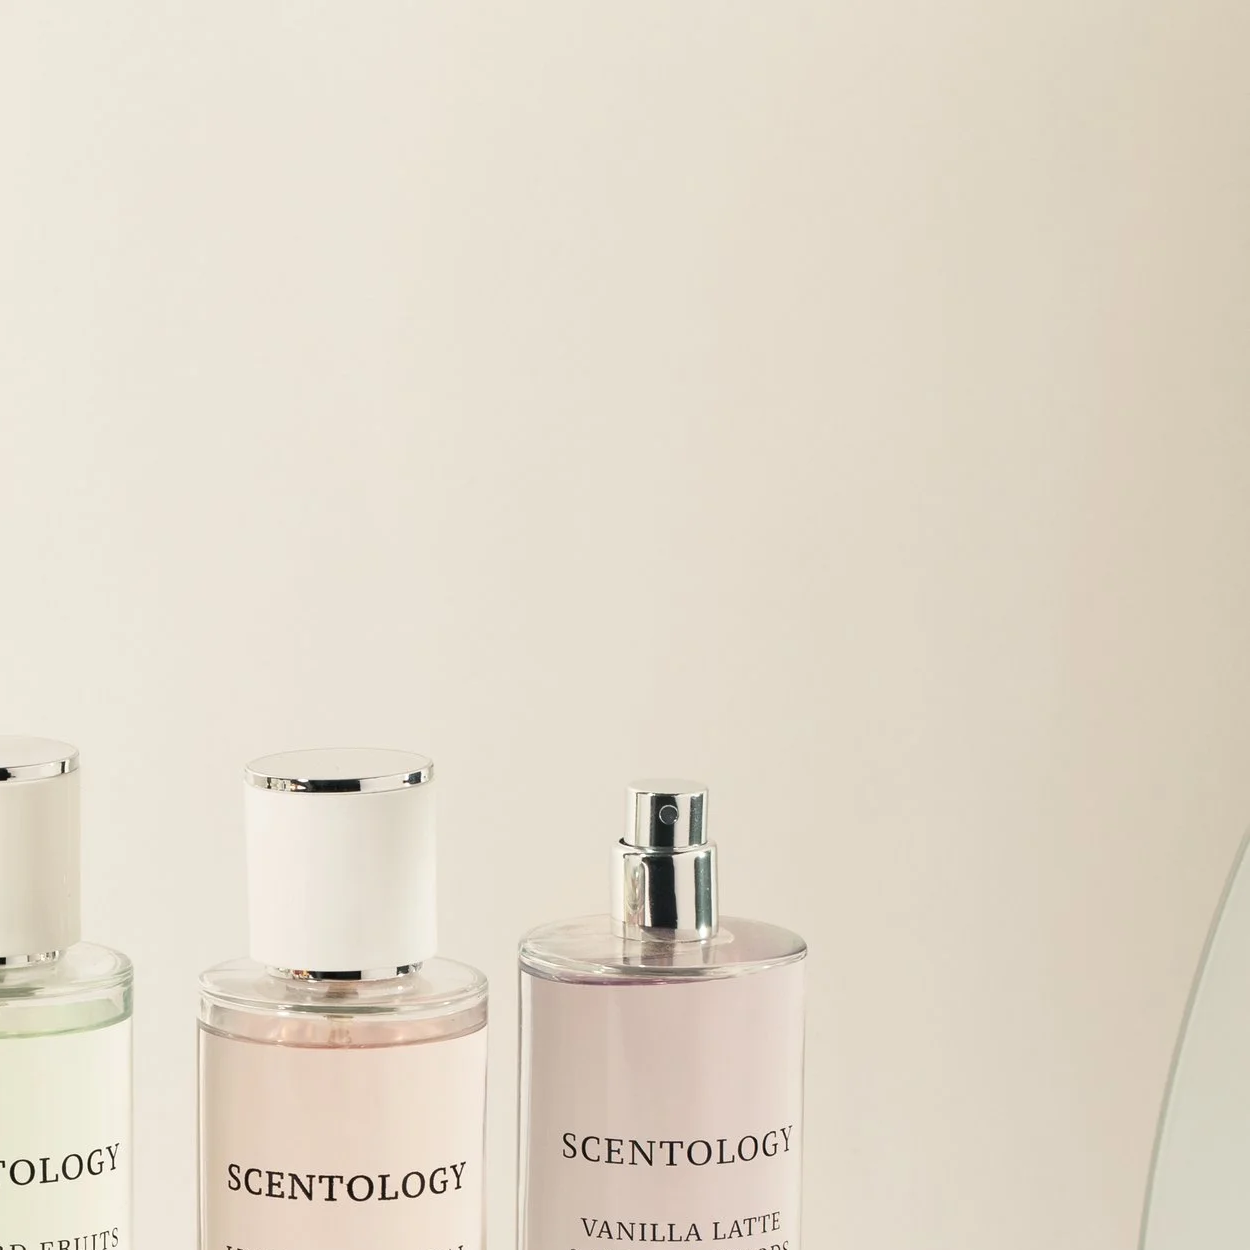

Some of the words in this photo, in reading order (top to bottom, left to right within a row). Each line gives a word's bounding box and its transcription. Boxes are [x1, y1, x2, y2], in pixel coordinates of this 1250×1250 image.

[562, 1124, 793, 1167] SCENTOLOGY
[227, 1160, 467, 1203] SCENTOLOGY
[580, 1216, 703, 1243] VANILLA
[712, 1210, 781, 1241] LATTE
